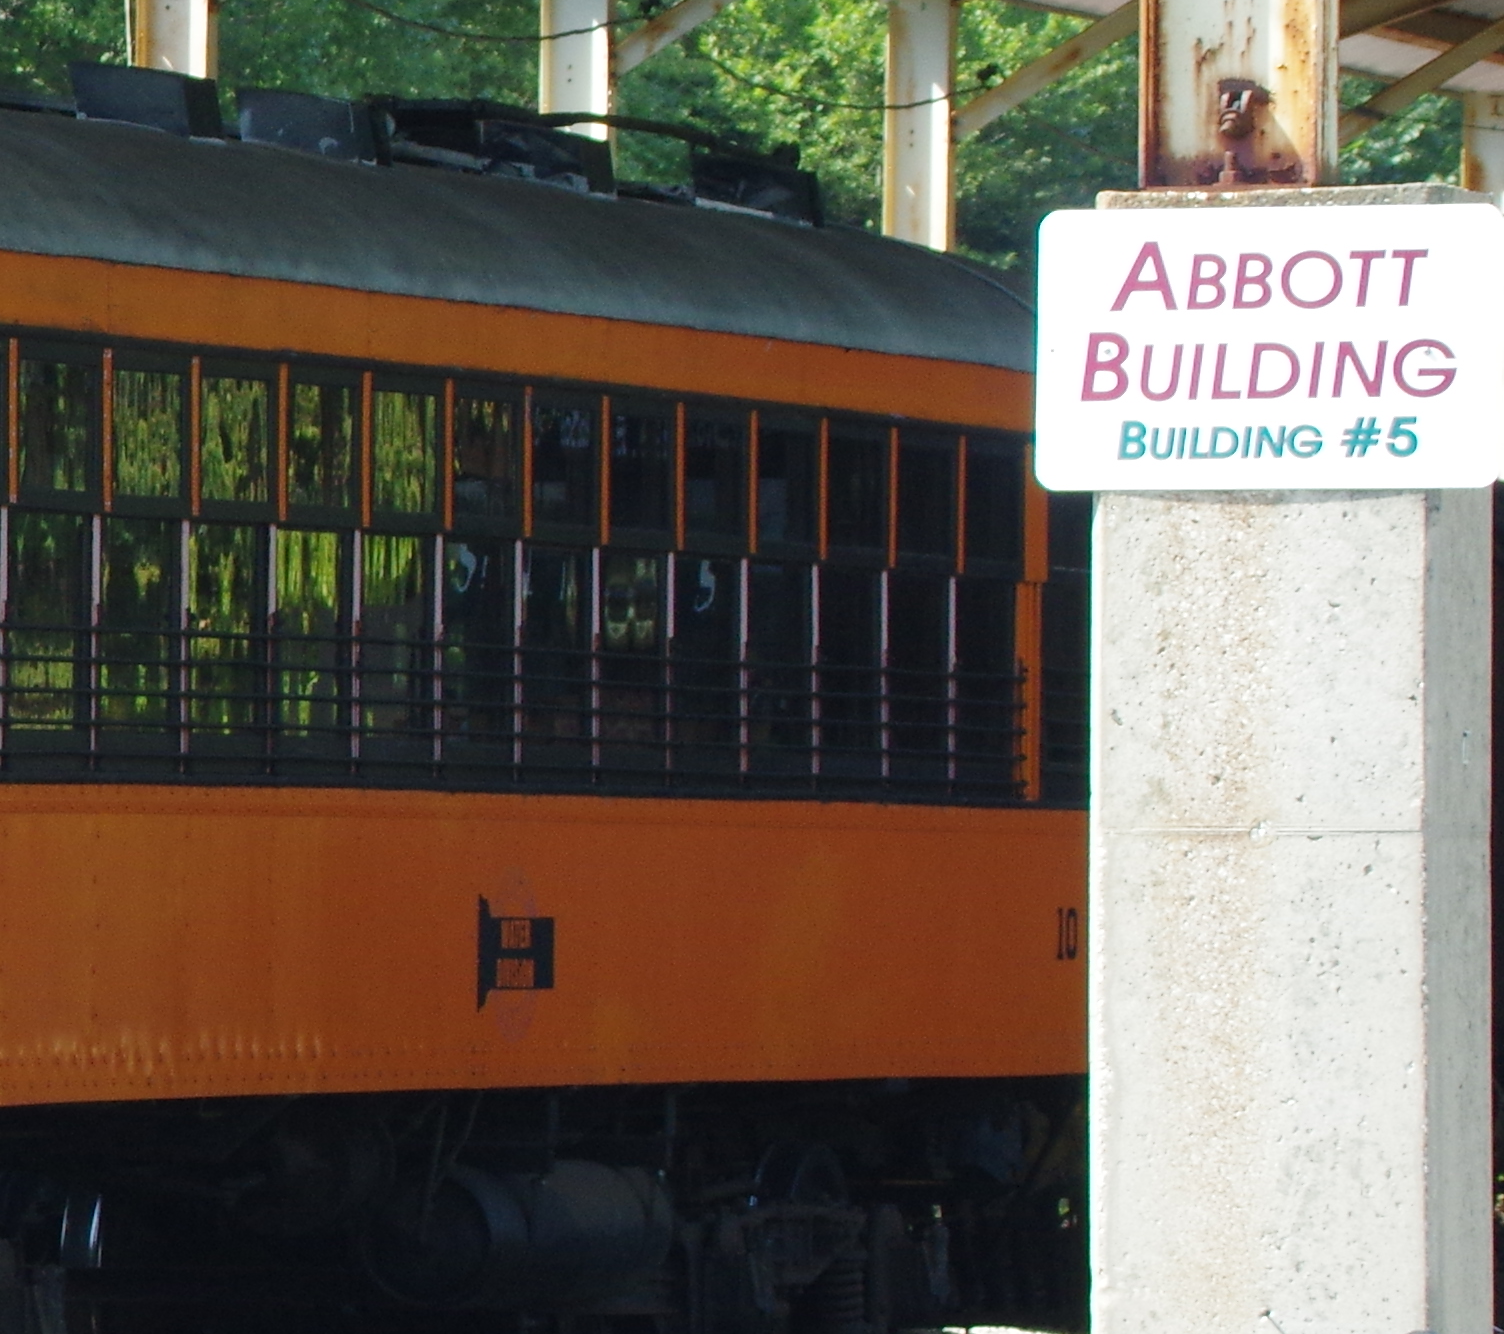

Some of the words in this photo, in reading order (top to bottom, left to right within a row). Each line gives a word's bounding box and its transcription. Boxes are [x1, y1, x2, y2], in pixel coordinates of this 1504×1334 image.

[1080, 331, 1458, 402] BUILDING
[1117, 419, 1323, 460] BUILDING
[1340, 415, 1419, 458] #5
[1056, 907, 1078, 961] 10
